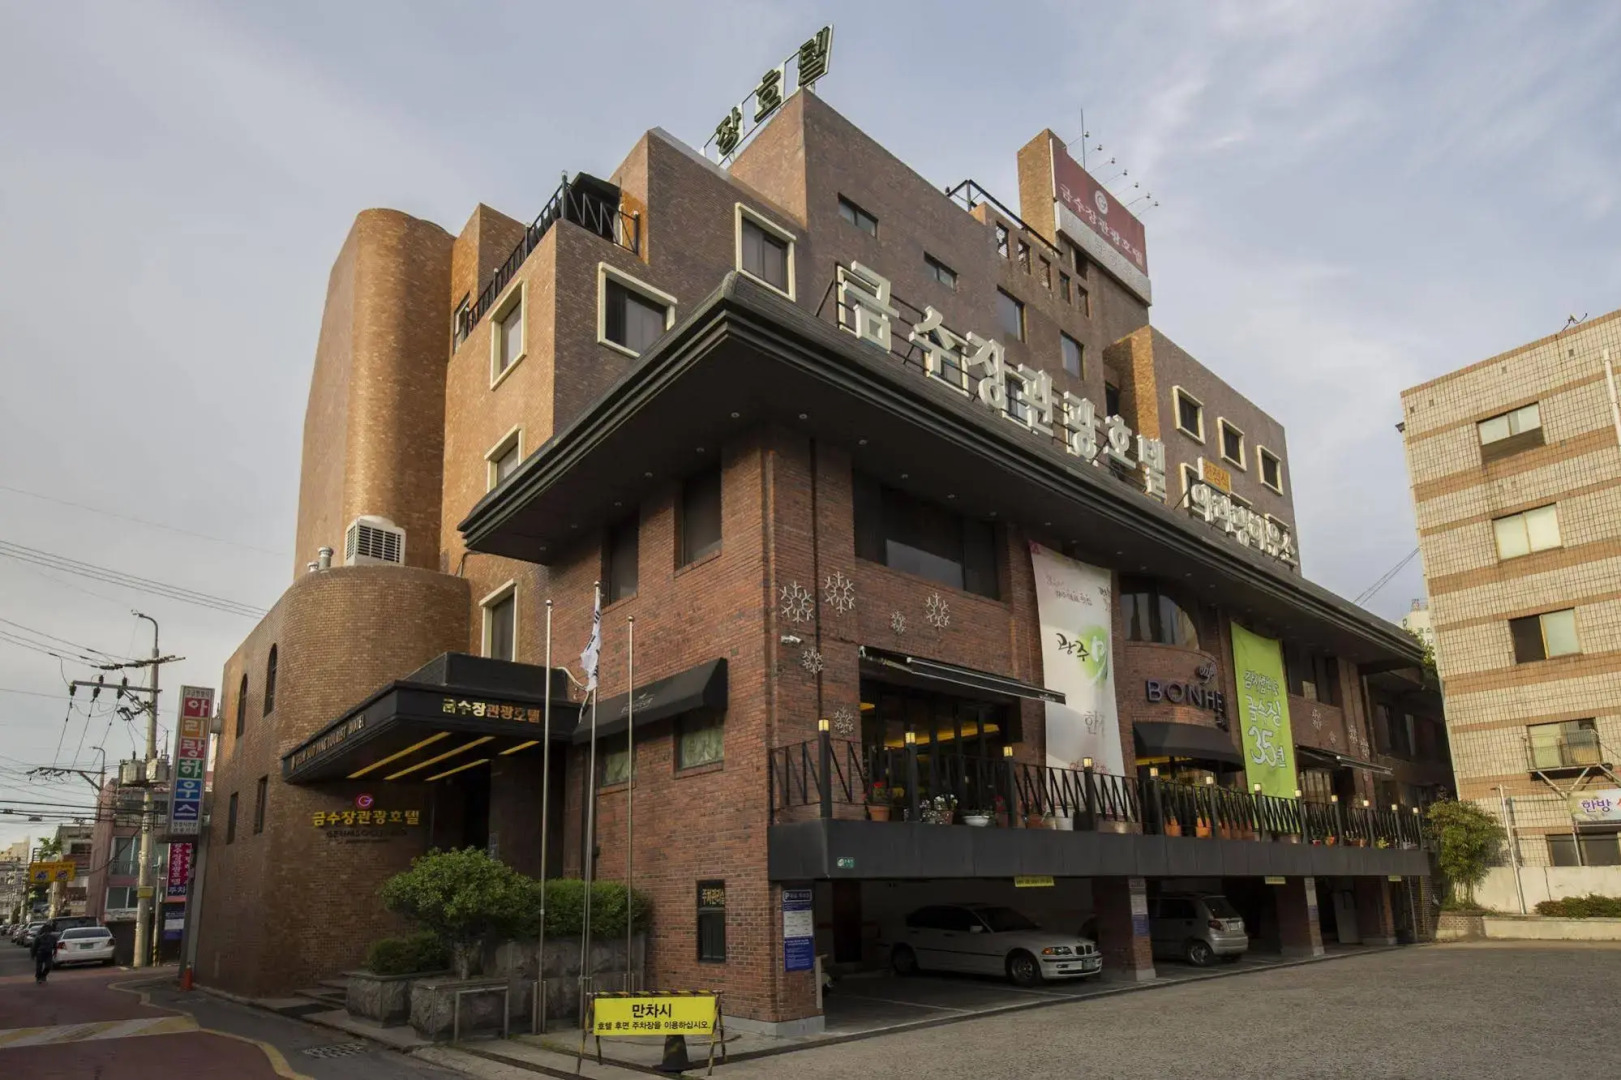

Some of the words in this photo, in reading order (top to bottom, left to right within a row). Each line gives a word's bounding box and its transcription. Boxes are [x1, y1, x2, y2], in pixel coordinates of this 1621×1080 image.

[1060, 184, 1143, 265] 금수장관광호텔
[841, 260, 1167, 501] 금수장관광호텔
[443, 698, 540, 723] 금수장관광호텔
[1246, 695, 1281, 727] 금수장
[174, 699, 208, 817] 아리랑하우스
[312, 810, 420, 827] 금수장관광호텔
[1581, 799, 1612, 813] 한방
[632, 1003, 672, 1018] 만차시
[597, 1021, 612, 1030] 호텔
[615, 1021, 629, 1030] 후면
[632, 1020, 661, 1030] 주차장을
[664, 1020, 711, 1030] 이용하십시오.
